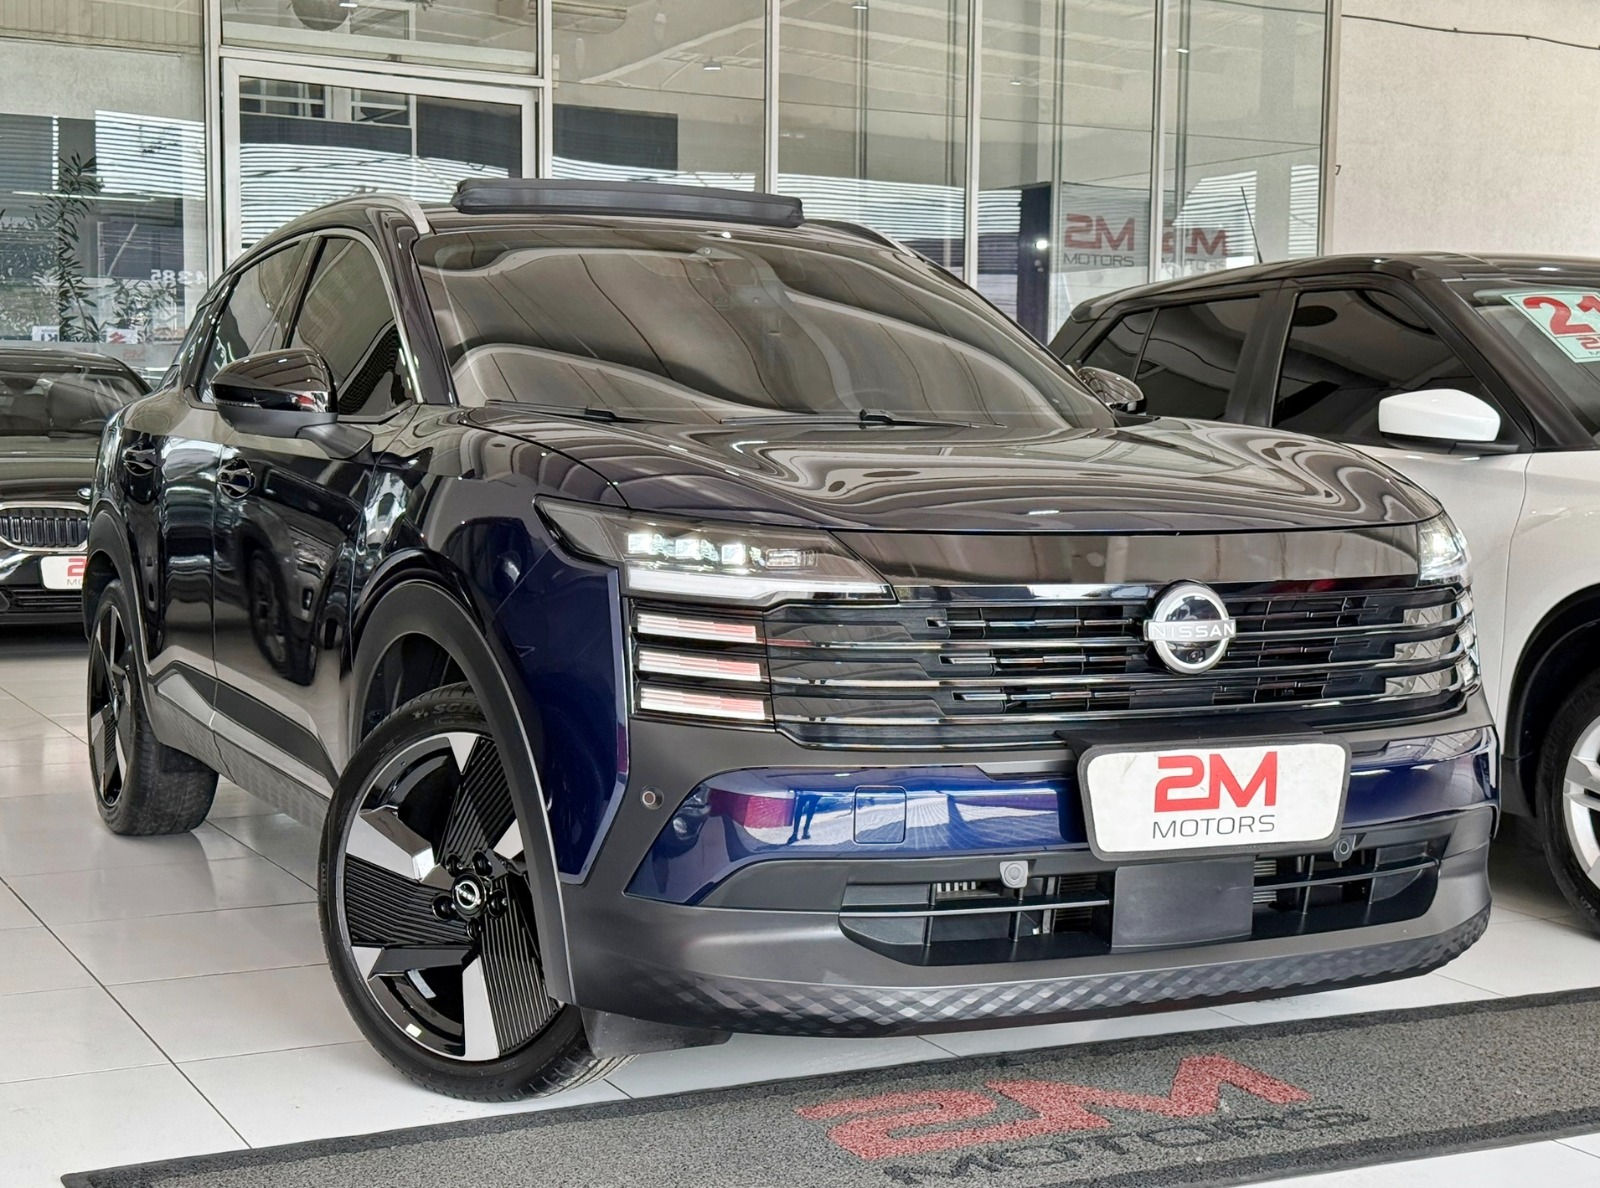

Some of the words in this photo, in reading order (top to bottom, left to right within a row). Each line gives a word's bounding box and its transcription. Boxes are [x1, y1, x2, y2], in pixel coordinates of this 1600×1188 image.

[1064, 213, 1136, 251] 2M
[1063, 252, 1135, 267] MOTORS
[1150, 622, 1236, 639] NISSAN
[1154, 751, 1278, 813] 2M
[1152, 814, 1276, 839] MOTORS
[797, 1054, 1313, 1160] 2M
[882, 1104, 1371, 1185] MOTORS
